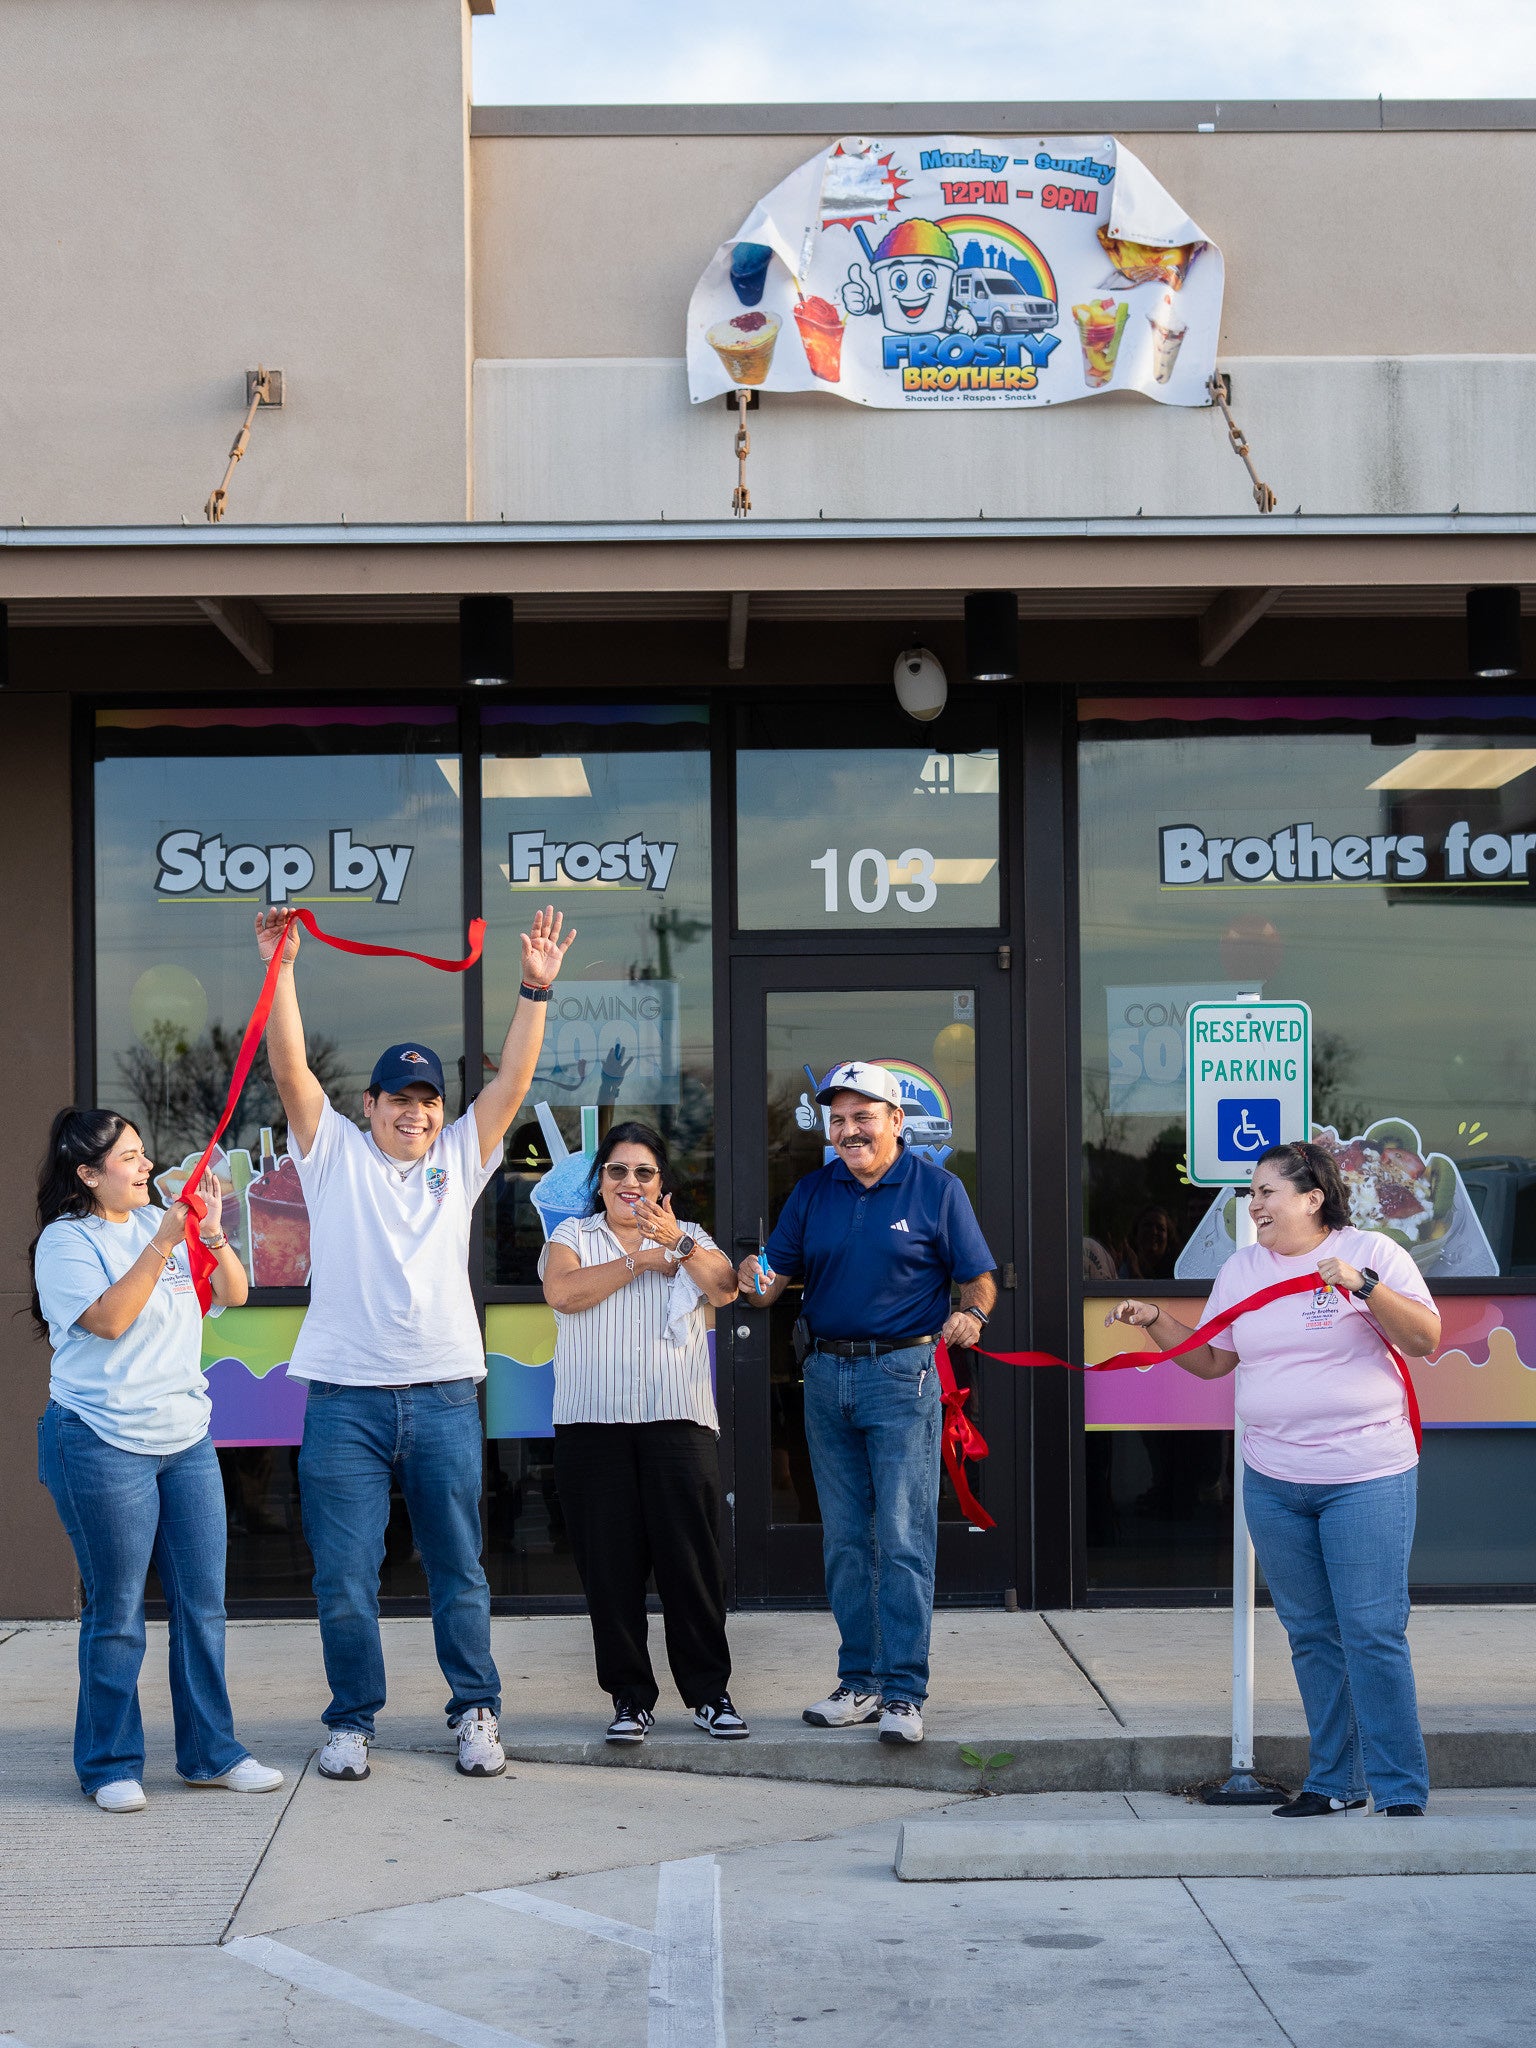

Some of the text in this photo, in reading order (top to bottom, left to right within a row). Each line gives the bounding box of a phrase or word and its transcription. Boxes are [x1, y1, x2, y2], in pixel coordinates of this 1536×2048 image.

[919, 149, 1009, 173] Monday
[1034, 152, 1116, 185] Sunday
[940, 180, 1009, 205] 12PM
[1041, 184, 1099, 215] 9PM
[882, 333, 1062, 369] FROSTY
[902, 366, 1039, 391] BROTHERS
[905, 393, 1037, 403] Shaved Ice Raspas Snacks
[153, 820, 1536, 905] Stop by Frosty Brothers for
[810, 847, 938, 914] 103
[1123, 1001, 1188, 1028] COM
[1196, 1020, 1303, 1044] RESERVED
[1109, 1027, 1187, 1085] SO
[1201, 1058, 1298, 1083] PARKING
